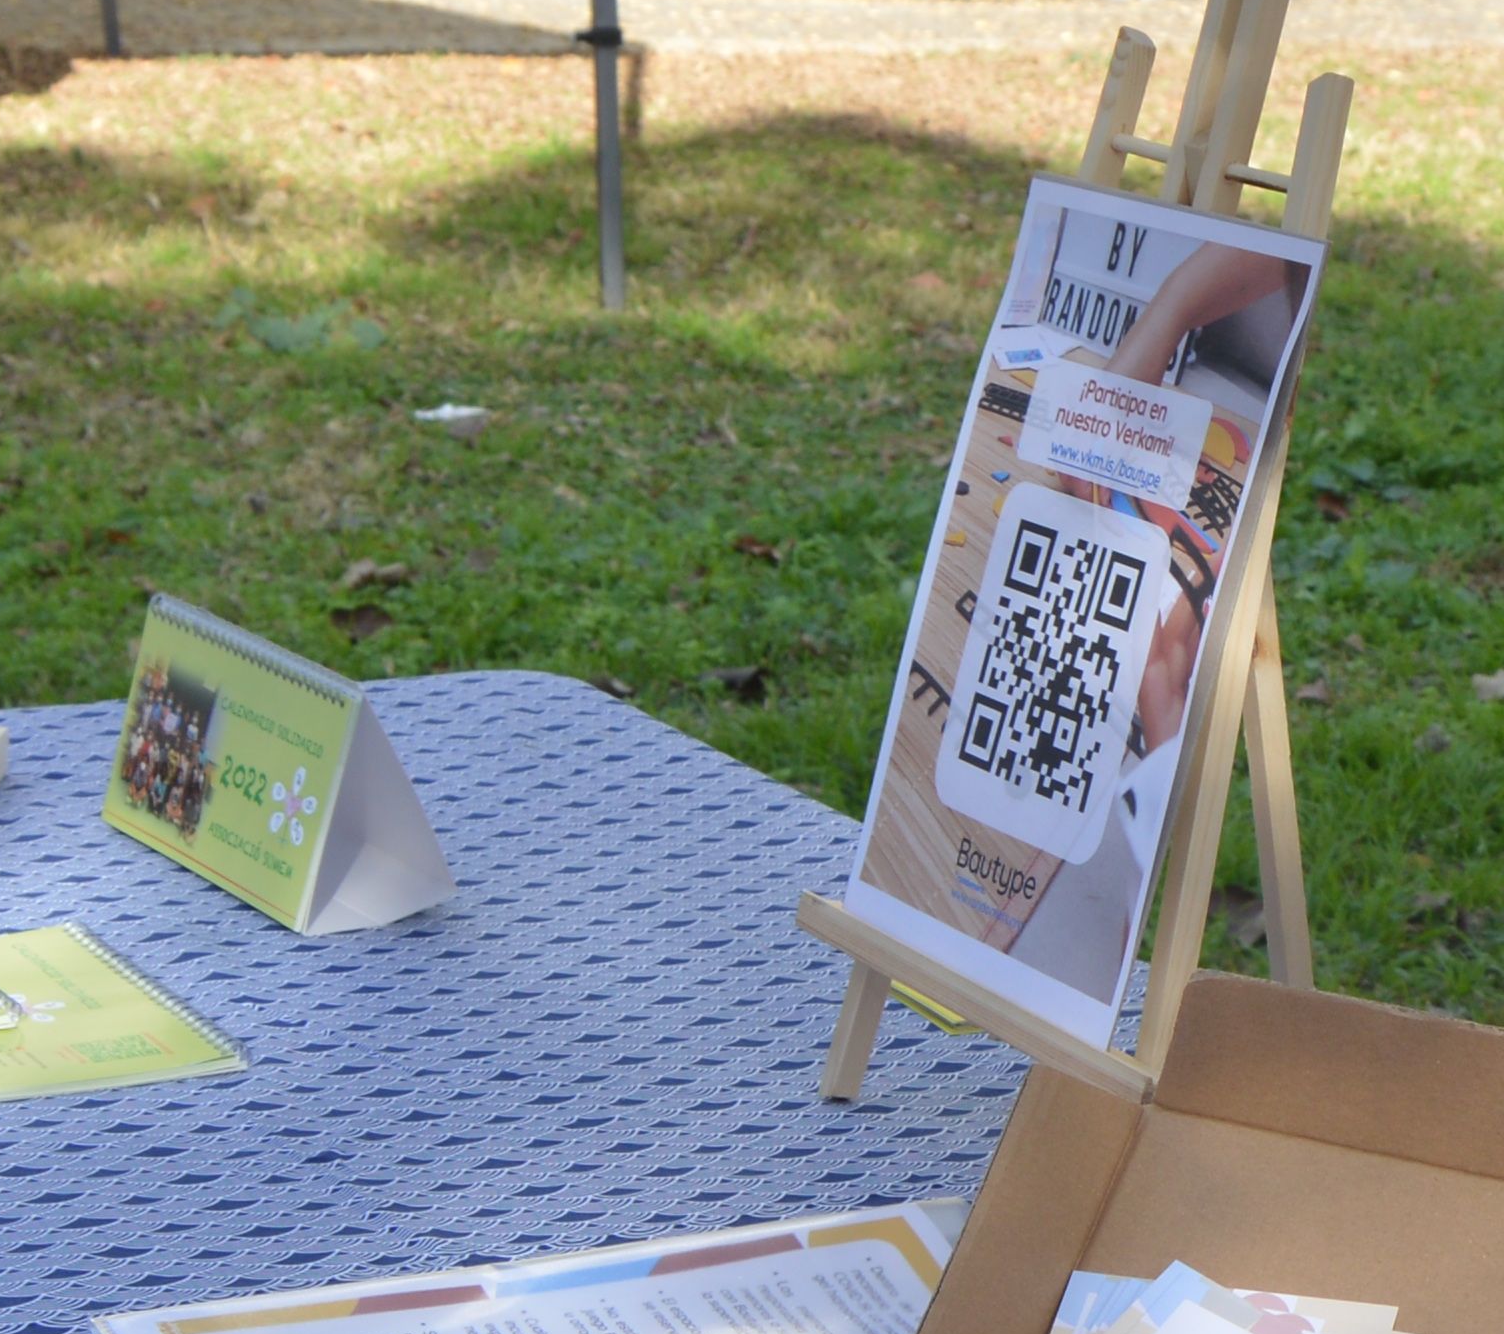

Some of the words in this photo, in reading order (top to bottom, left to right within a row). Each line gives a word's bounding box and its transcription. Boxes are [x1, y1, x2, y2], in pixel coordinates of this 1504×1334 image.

[1107, 222, 1147, 278] BY
[1079, 380, 1147, 416] ¡Participa
[1149, 402, 1168, 423] en
[1055, 405, 1112, 437] nuestro
[1116, 422, 1175, 457] Verkami!
[1049, 440, 1161, 488] www.vkm.is/bautype
[221, 696, 274, 734] CALENDARIO
[277, 725, 325, 760] SOLIDARIO
[220, 754, 269, 806] 2022
[956, 838, 1036, 899] Bautype
